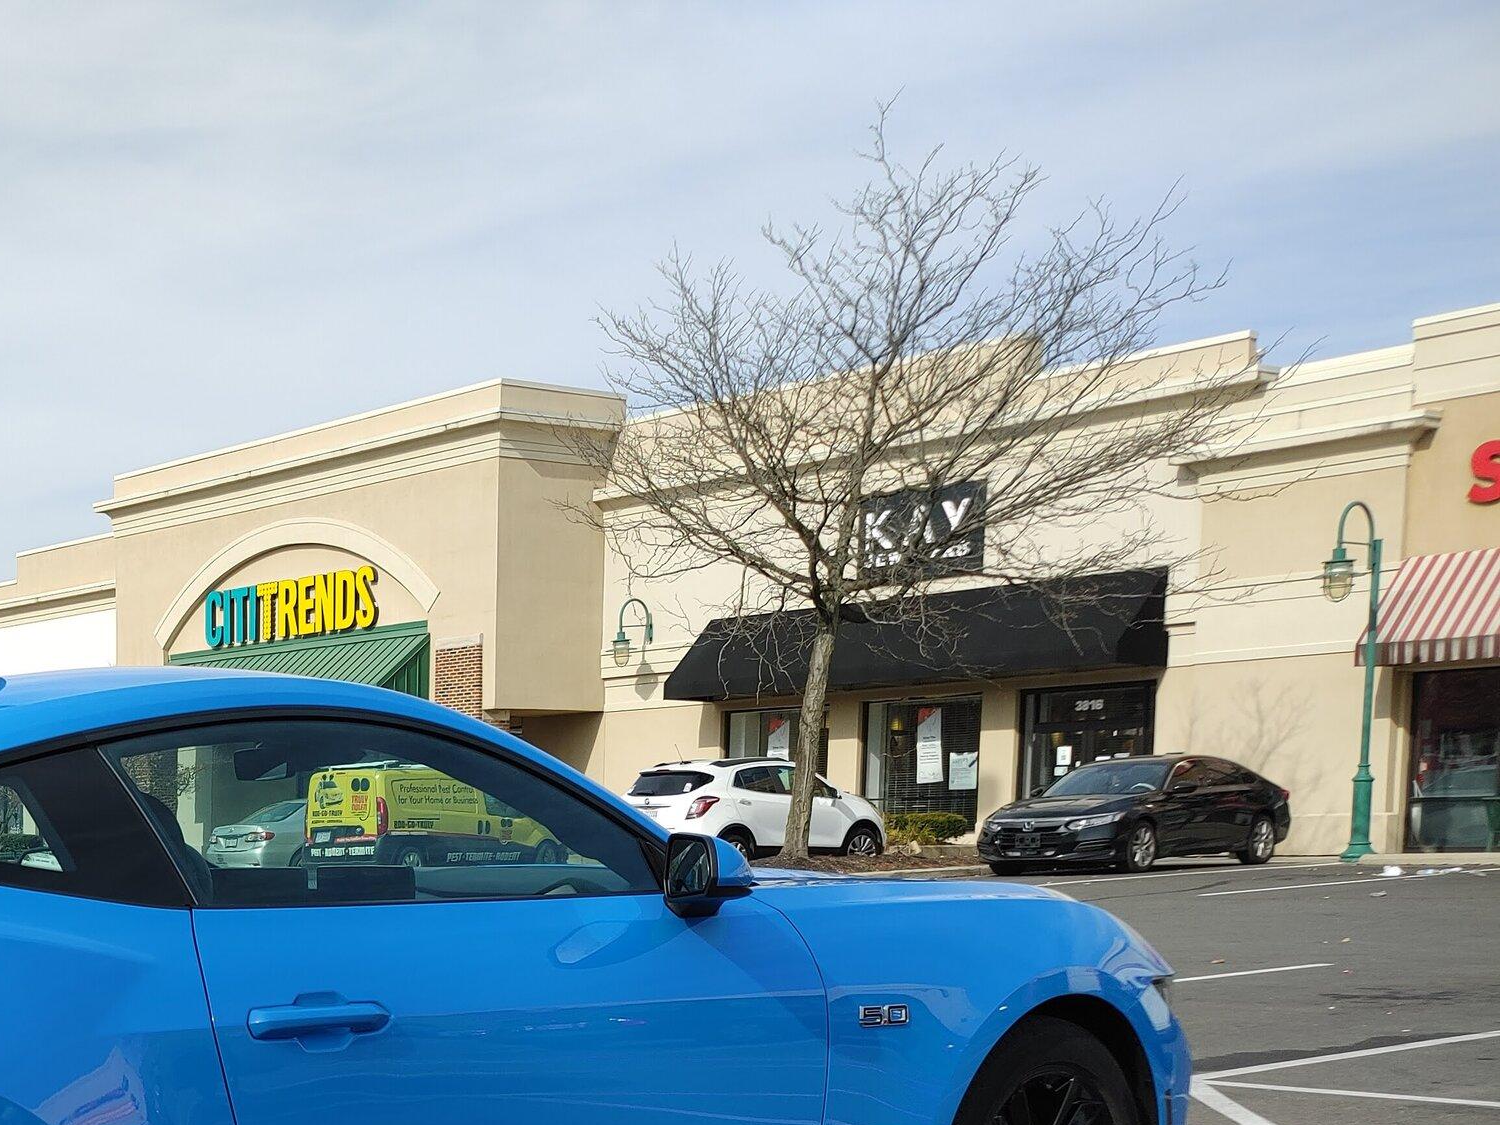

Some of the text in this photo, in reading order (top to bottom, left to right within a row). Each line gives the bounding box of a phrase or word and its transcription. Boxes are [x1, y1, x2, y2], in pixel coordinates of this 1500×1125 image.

[865, 497, 971, 550] KAY
[399, 783, 438, 793] Professional
[439, 785, 451, 793] Pest
[398, 795, 408, 804] for
[409, 795, 424, 804] Your
[424, 795, 443, 804] Home
[453, 796, 479, 804] Business
[348, 846, 375, 856] TERMITE
[447, 851, 522, 862] PEST TERMITE RODENT
